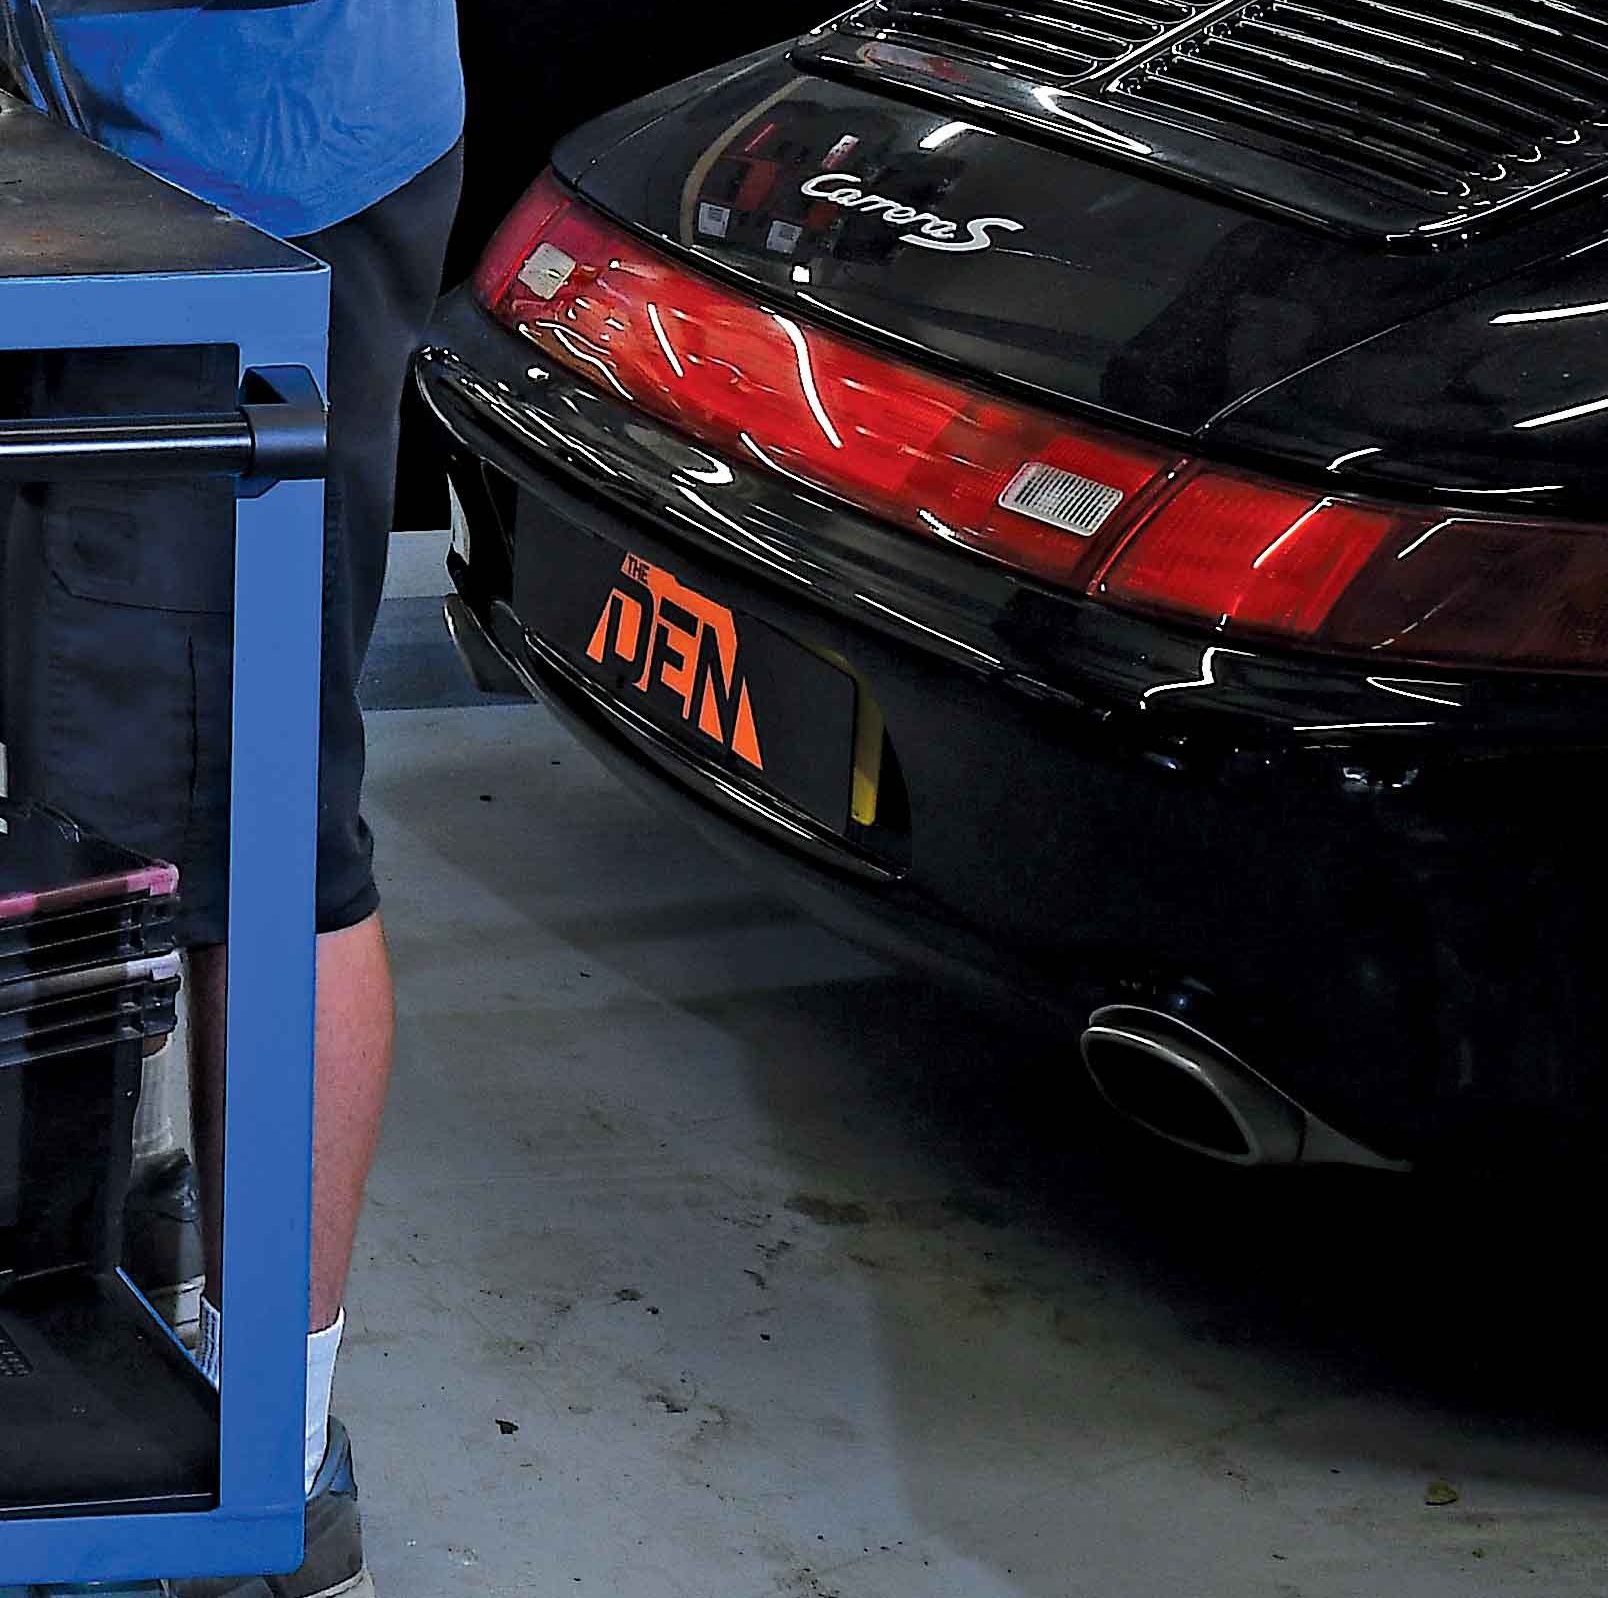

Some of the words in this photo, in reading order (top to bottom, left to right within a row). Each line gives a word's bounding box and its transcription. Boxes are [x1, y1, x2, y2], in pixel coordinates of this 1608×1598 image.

[800, 173, 958, 239] Carrera
[627, 555, 651, 582] THE
[600, 573, 746, 750] DEN
